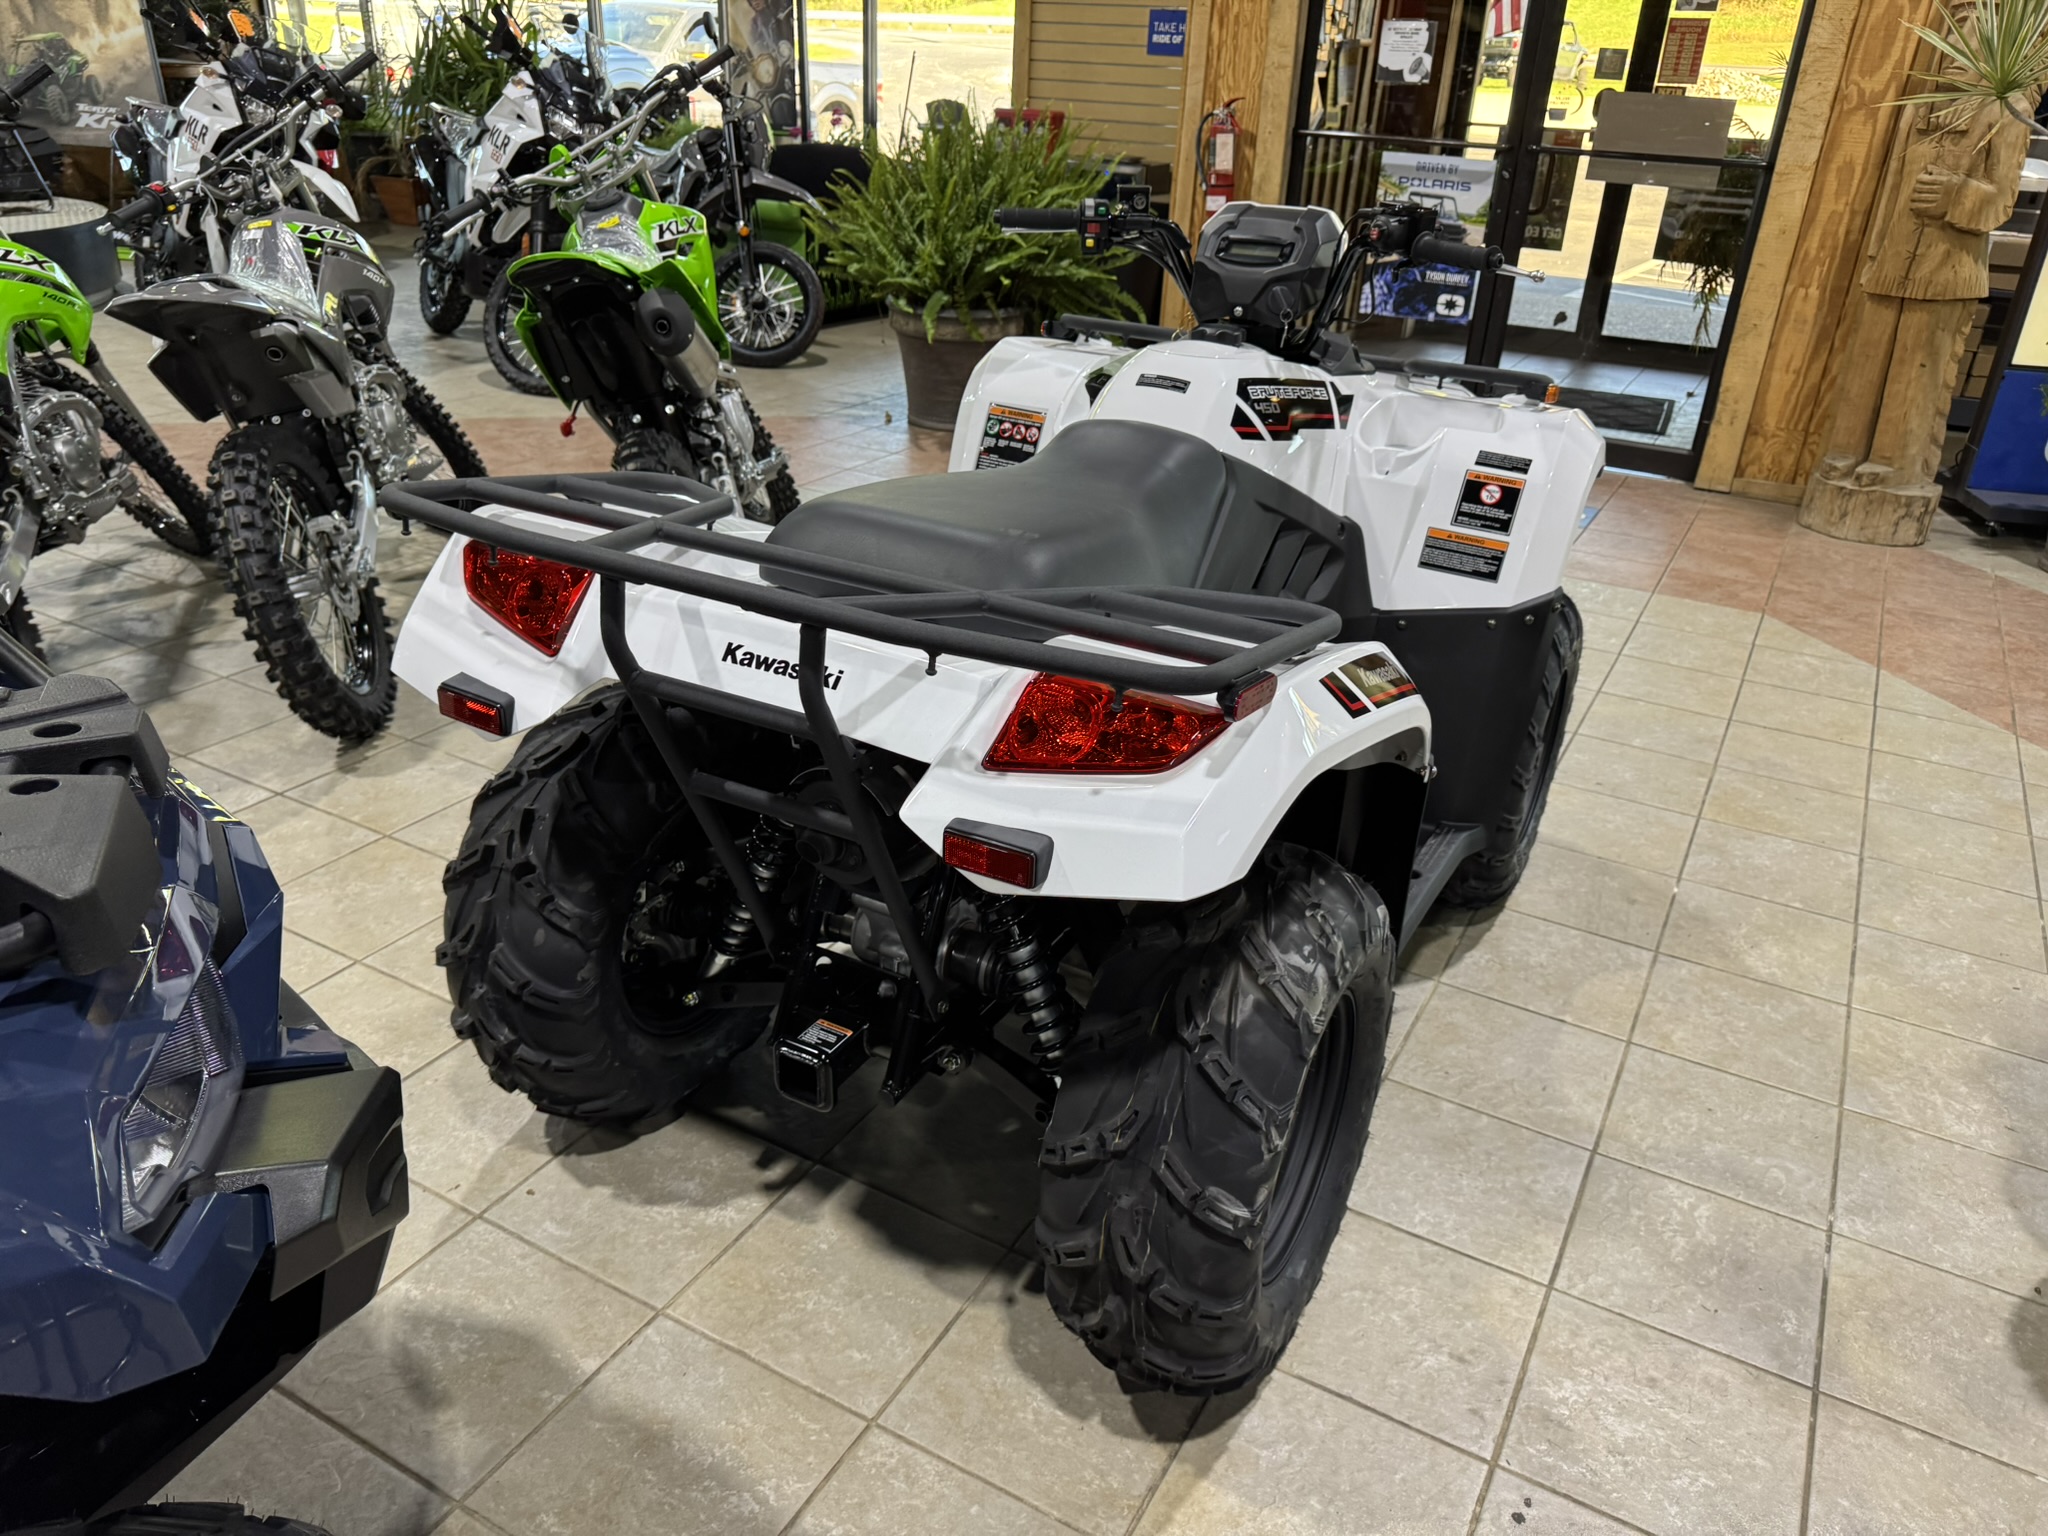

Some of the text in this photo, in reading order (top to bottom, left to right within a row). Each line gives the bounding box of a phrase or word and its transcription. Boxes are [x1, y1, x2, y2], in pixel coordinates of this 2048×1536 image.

[1154, 21, 1177, 33] TAKE
[1152, 34, 1184, 44] RIDE OF
[185, 115, 209, 144] KLR
[487, 125, 510, 155] KLR
[1415, 161, 1458, 174] DRIVEN BY
[1397, 176, 1472, 192] POLARIS
[656, 216, 697, 240] KLX
[1254, 402, 1280, 414] 450
[1483, 474, 1517, 486] WARNING
[1454, 533, 1485, 546] WARNING
[721, 641, 845, 691] Kawaski
